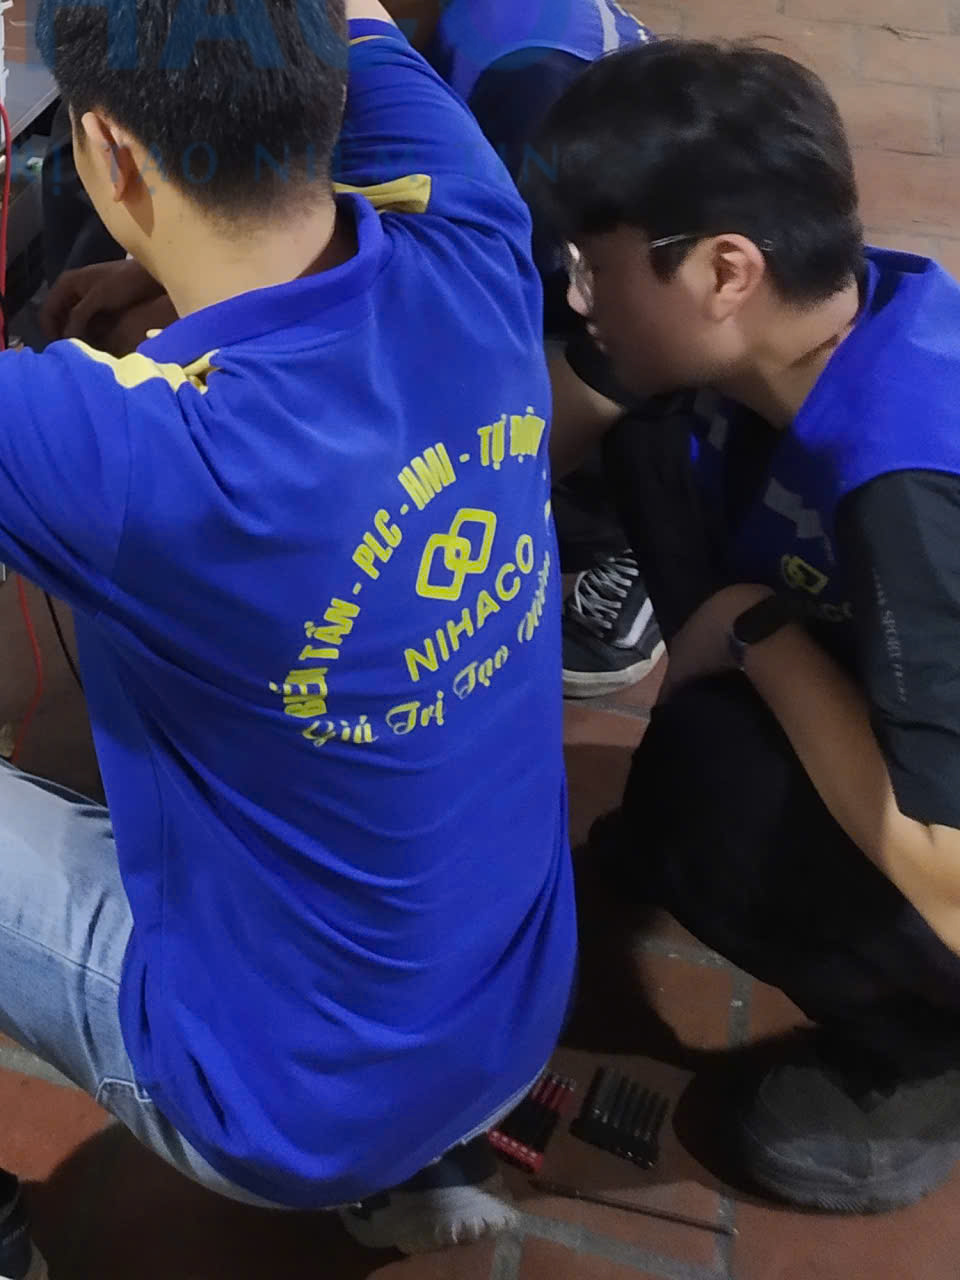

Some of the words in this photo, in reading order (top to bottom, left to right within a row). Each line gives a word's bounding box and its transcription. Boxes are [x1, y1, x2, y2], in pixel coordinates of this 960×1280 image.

[352, 509, 402, 580] PLC
[398, 442, 457, 510] HMI
[477, 414, 507, 470] TỰ
[404, 534, 534, 682] NIHACO
